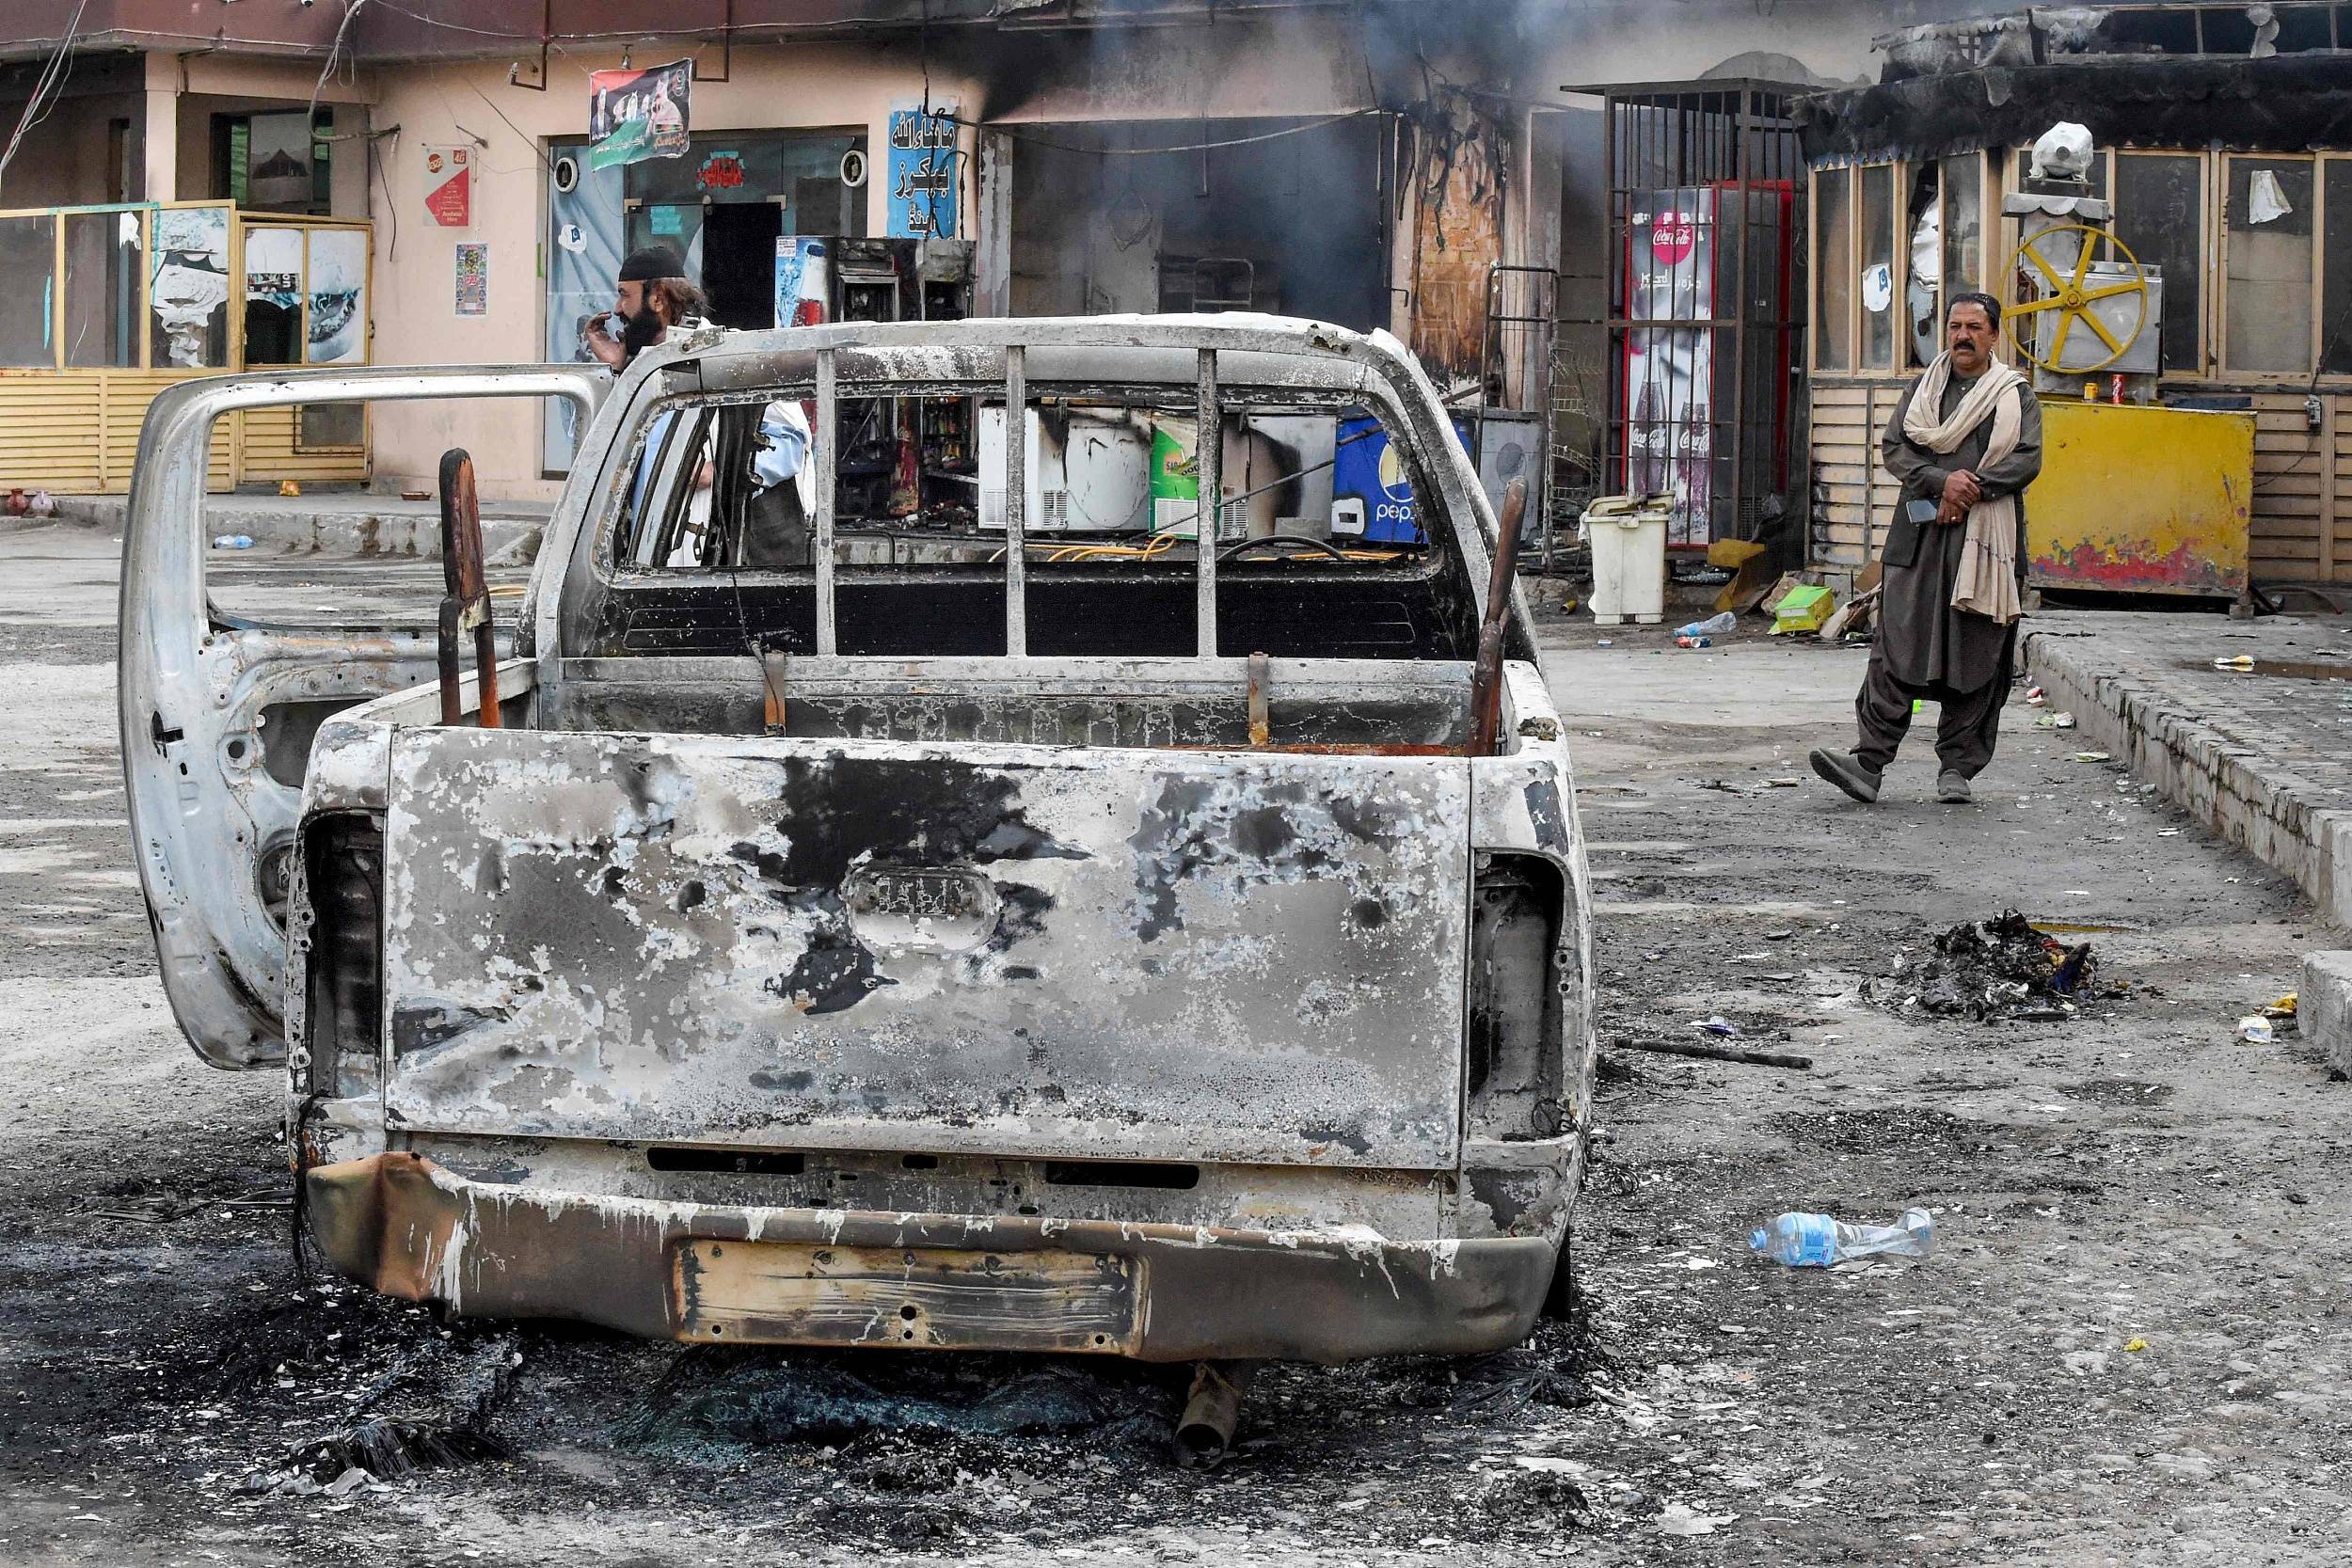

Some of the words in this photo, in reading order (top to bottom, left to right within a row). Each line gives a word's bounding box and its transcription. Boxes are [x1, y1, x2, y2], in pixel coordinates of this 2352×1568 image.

[1653, 229, 1692, 245] CocaCola
[1632, 427, 1666, 449] ocaCola
[1375, 503, 1416, 523] pep
